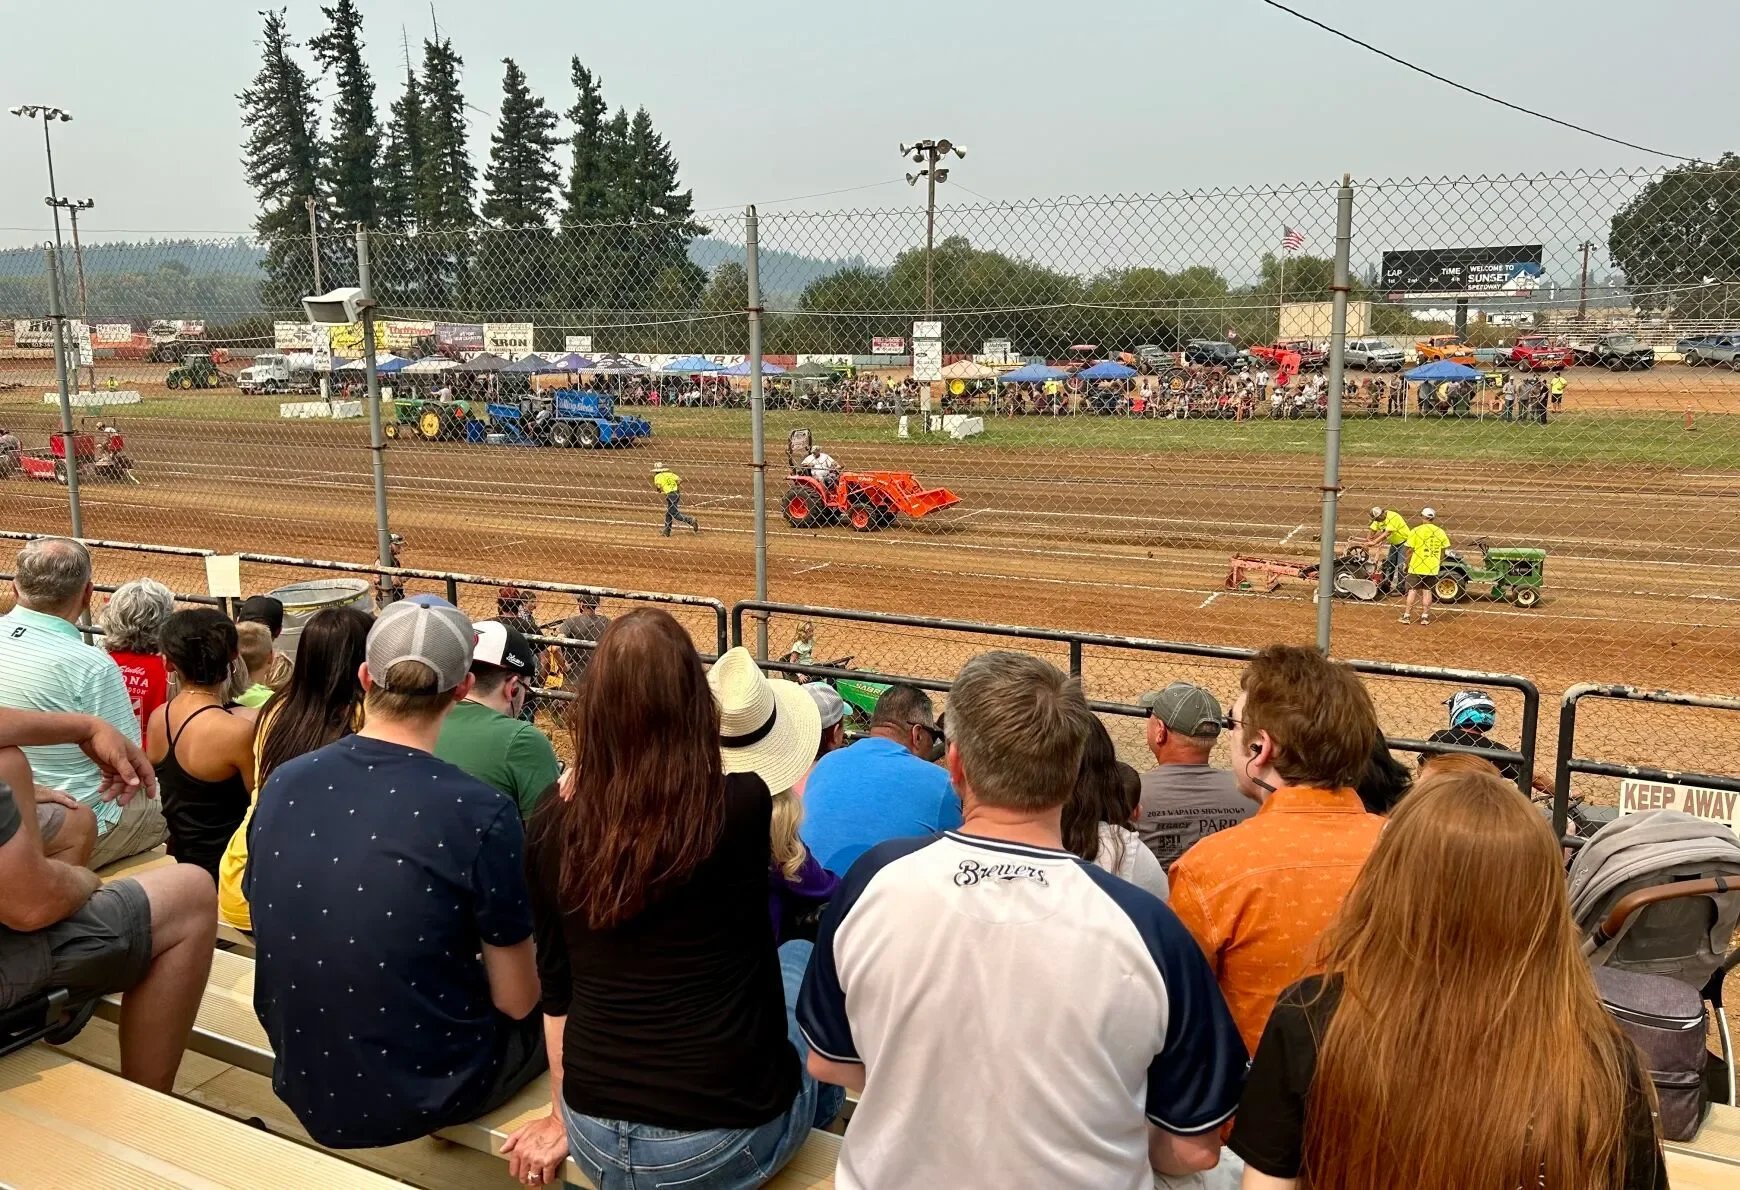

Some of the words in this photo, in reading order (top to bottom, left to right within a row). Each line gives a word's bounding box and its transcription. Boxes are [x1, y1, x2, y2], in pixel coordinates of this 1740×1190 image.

[1387, 269, 1403, 277] LAP
[1441, 267, 1461, 275] TIME
[1467, 273, 1509, 283] SUNSET
[1624, 782, 1676, 811] KEEP
[1682, 788, 1738, 822] AWAY
[1167, 808, 1200, 816] WAPATO
[1201, 807, 1246, 815] SHOWDOWN
[953, 859, 1050, 888] Brewers
